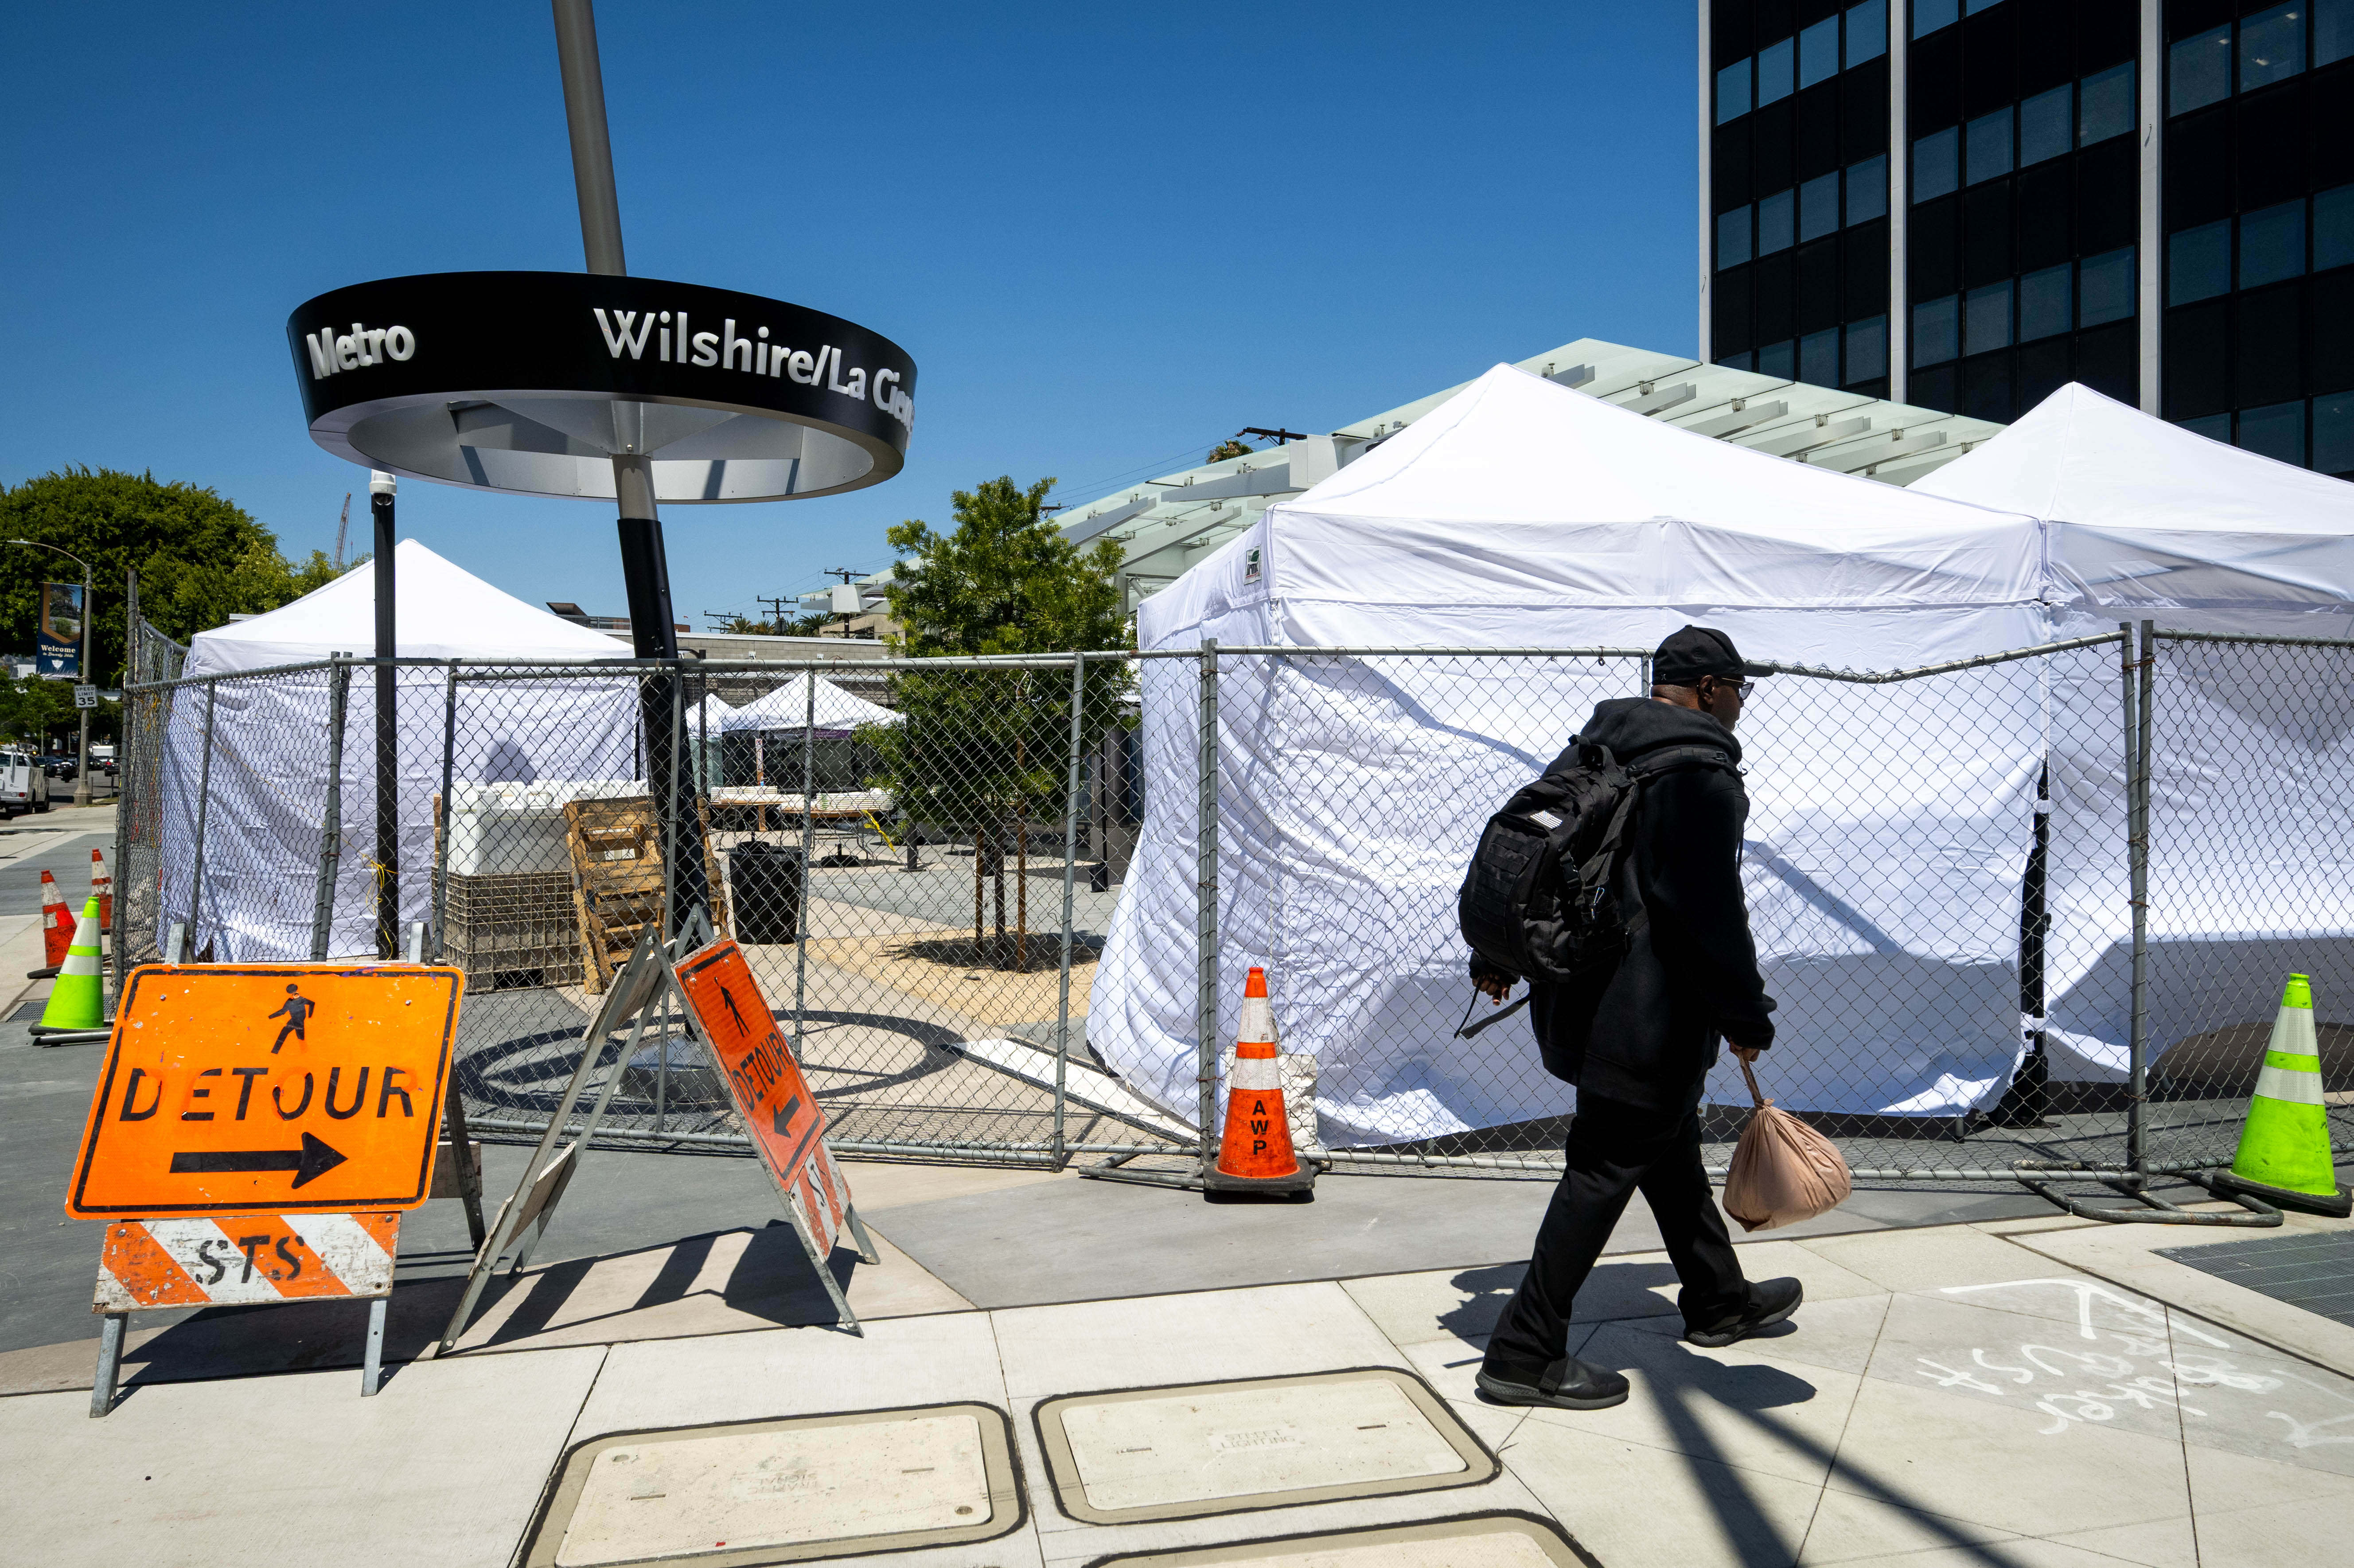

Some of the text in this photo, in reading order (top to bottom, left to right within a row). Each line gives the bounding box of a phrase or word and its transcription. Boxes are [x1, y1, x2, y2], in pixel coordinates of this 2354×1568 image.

[307, 323, 415, 380] Metro
[78, 697, 95, 705] 35
[120, 1066, 414, 1121] DETOUR
[731, 1032, 792, 1112] DETOUR
[196, 1235, 304, 1285] STS
